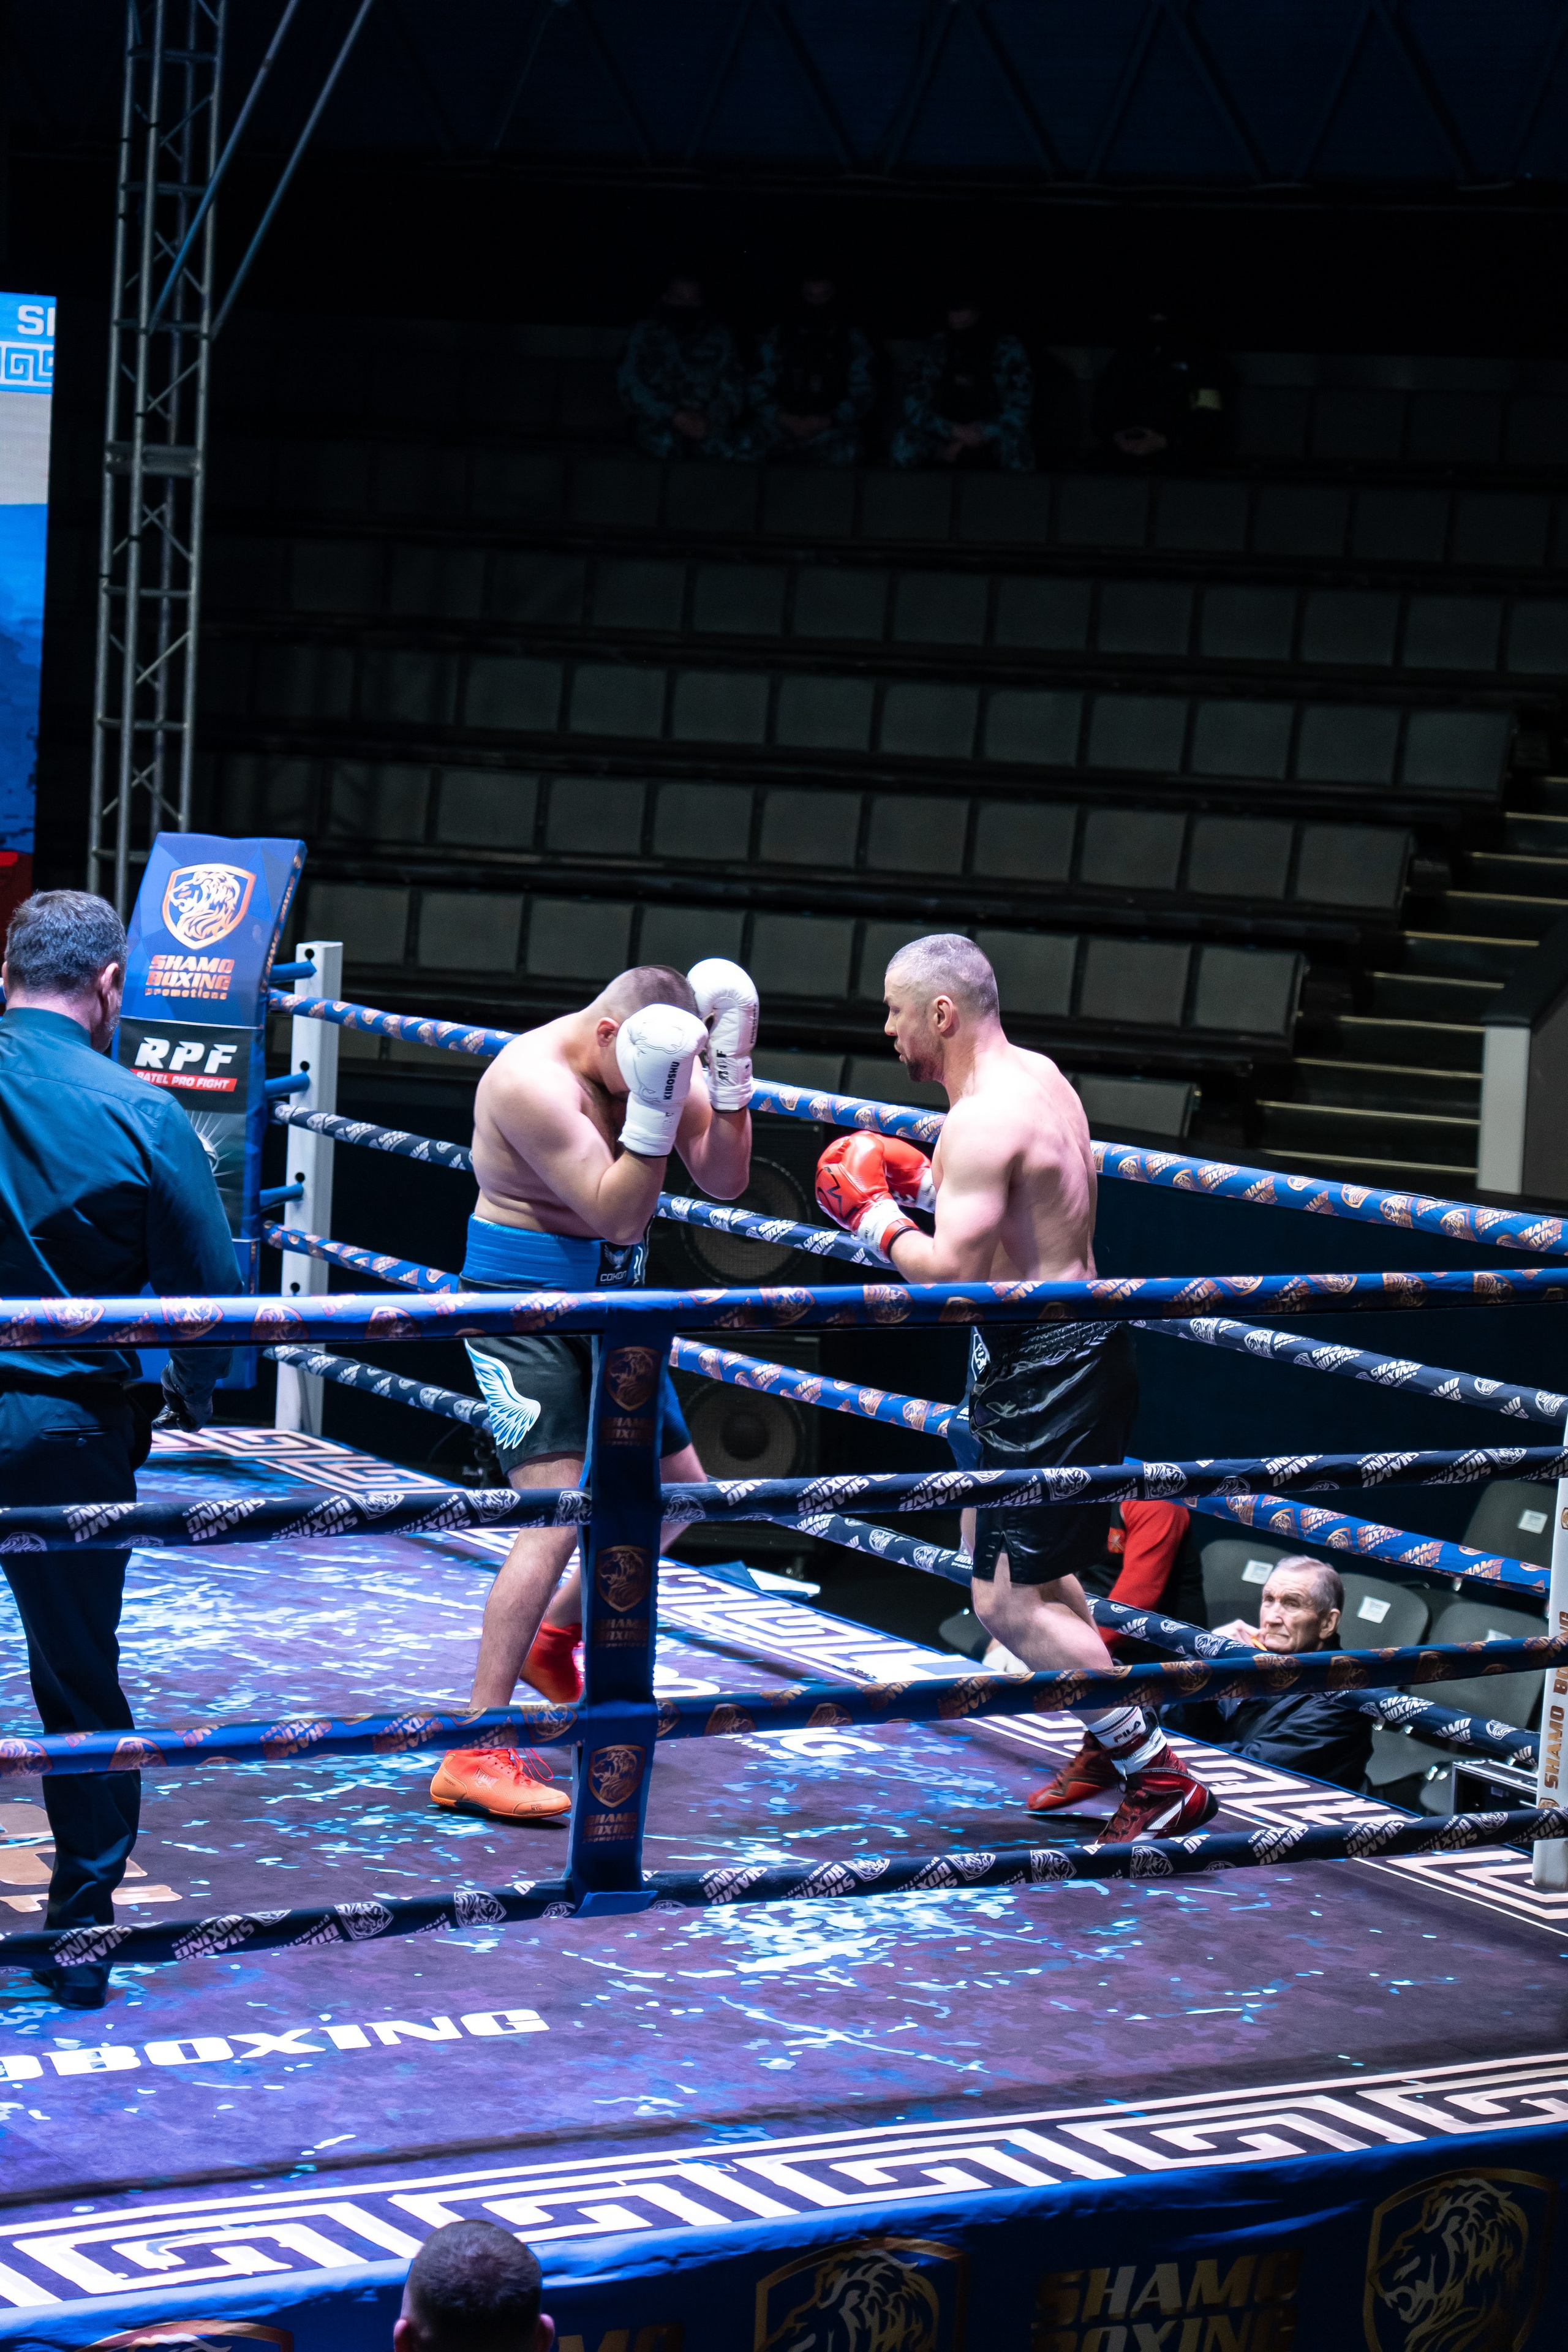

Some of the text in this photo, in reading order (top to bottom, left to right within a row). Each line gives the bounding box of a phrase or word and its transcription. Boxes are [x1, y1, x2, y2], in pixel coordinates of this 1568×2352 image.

[149, 954, 235, 974] SHAMO
[145, 971, 232, 990] BOXING
[145, 987, 227, 1000] promotions
[135, 1036, 238, 1074] RPF
[171, 1075, 195, 1087] PRO
[196, 1077, 230, 1090] FIGHT
[1113, 1721, 1142, 1743] FILA
[1544, 1705, 1566, 1790] SHAMO
[1030, 2247, 1305, 2330] SHAMO
